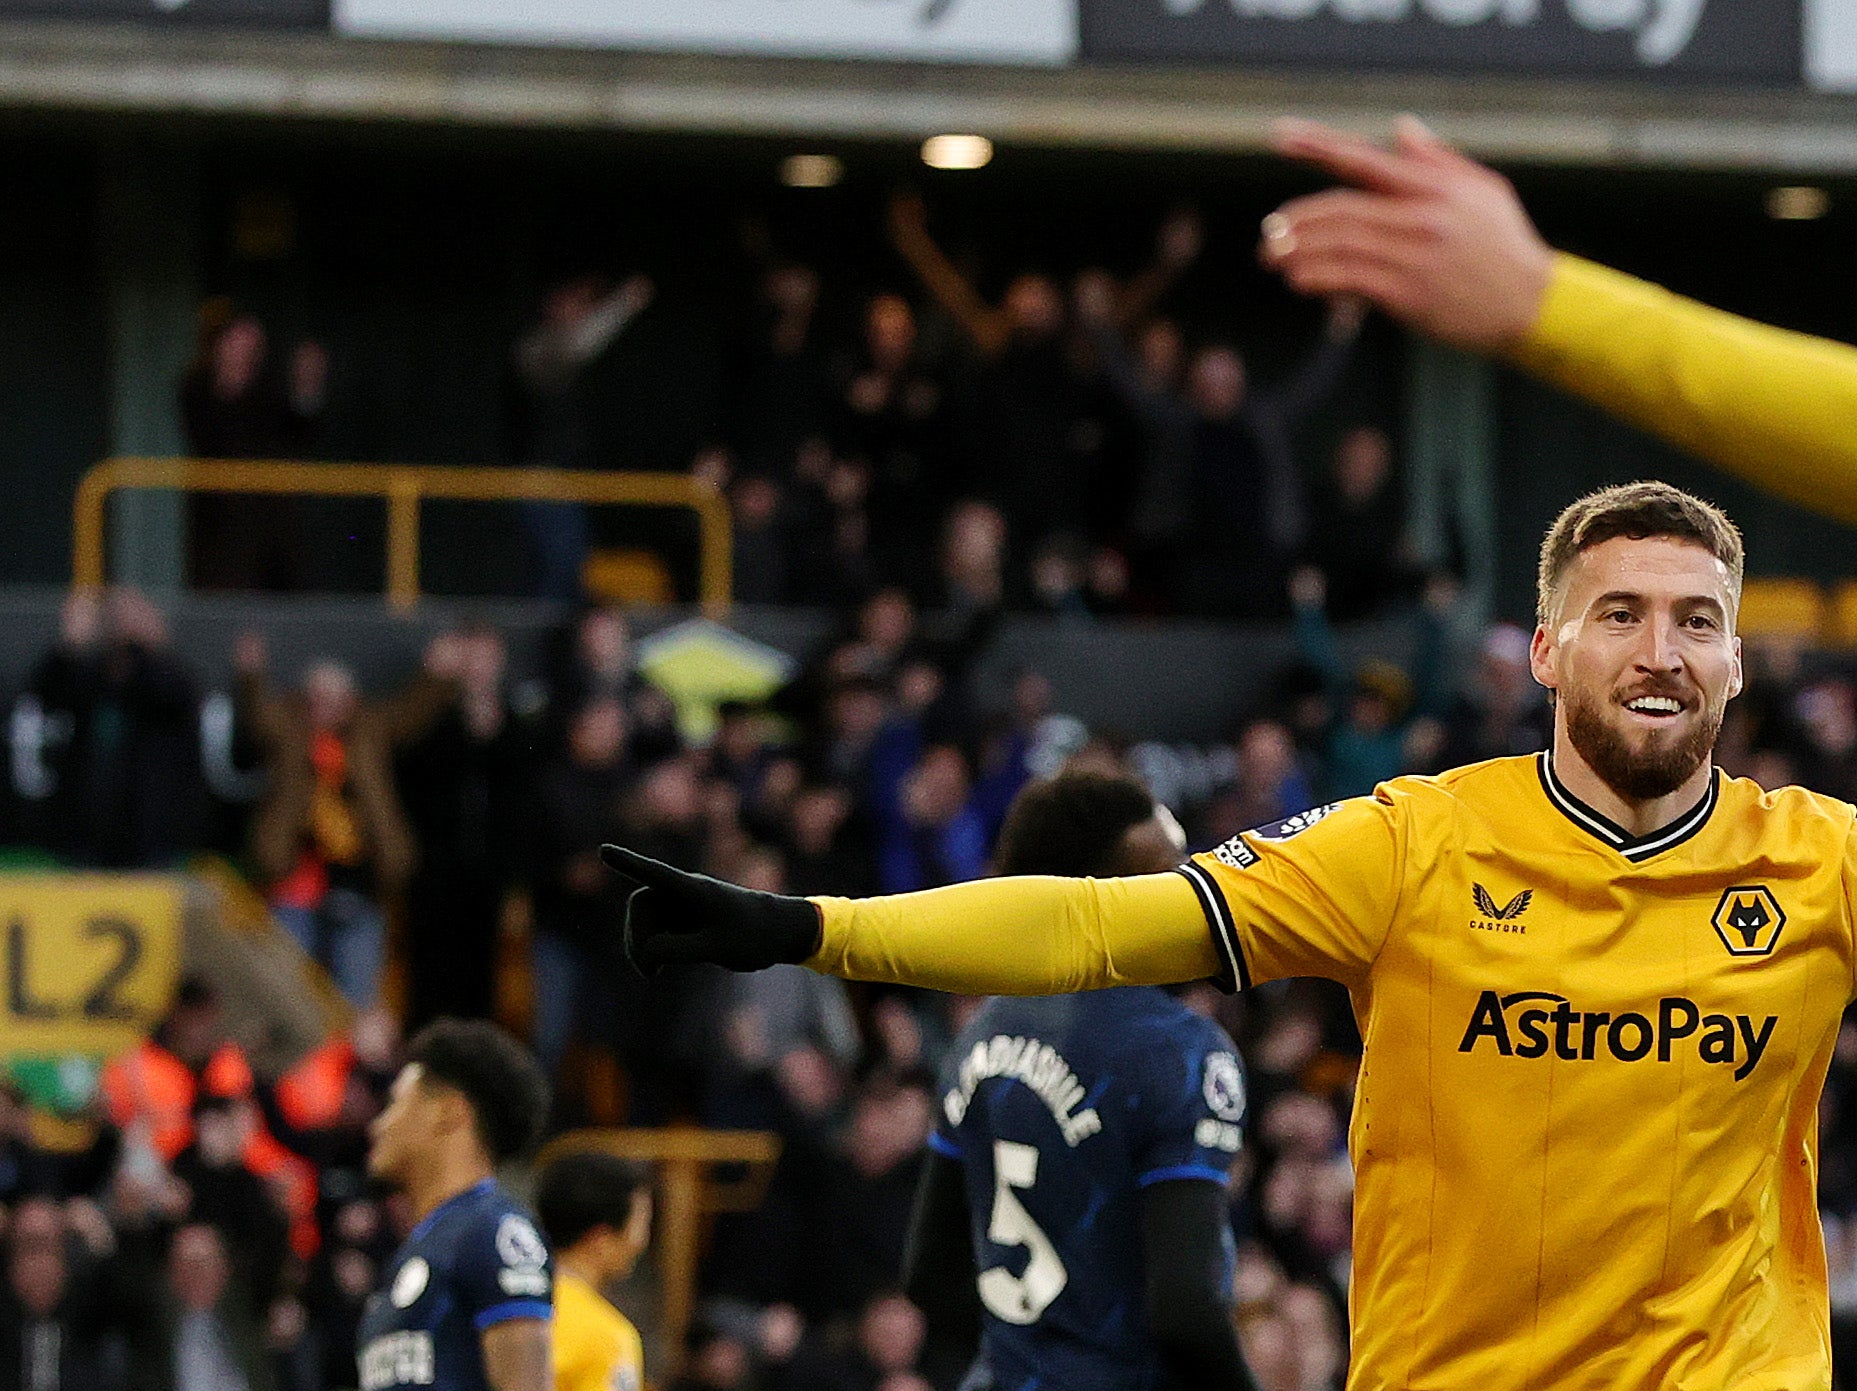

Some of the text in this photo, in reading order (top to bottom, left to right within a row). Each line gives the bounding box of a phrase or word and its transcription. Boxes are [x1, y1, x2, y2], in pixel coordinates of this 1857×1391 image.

[1469, 920, 1527, 935] CASTORE
[1457, 990, 1778, 1082] AstroPay
[977, 1138, 1068, 1326] 5
